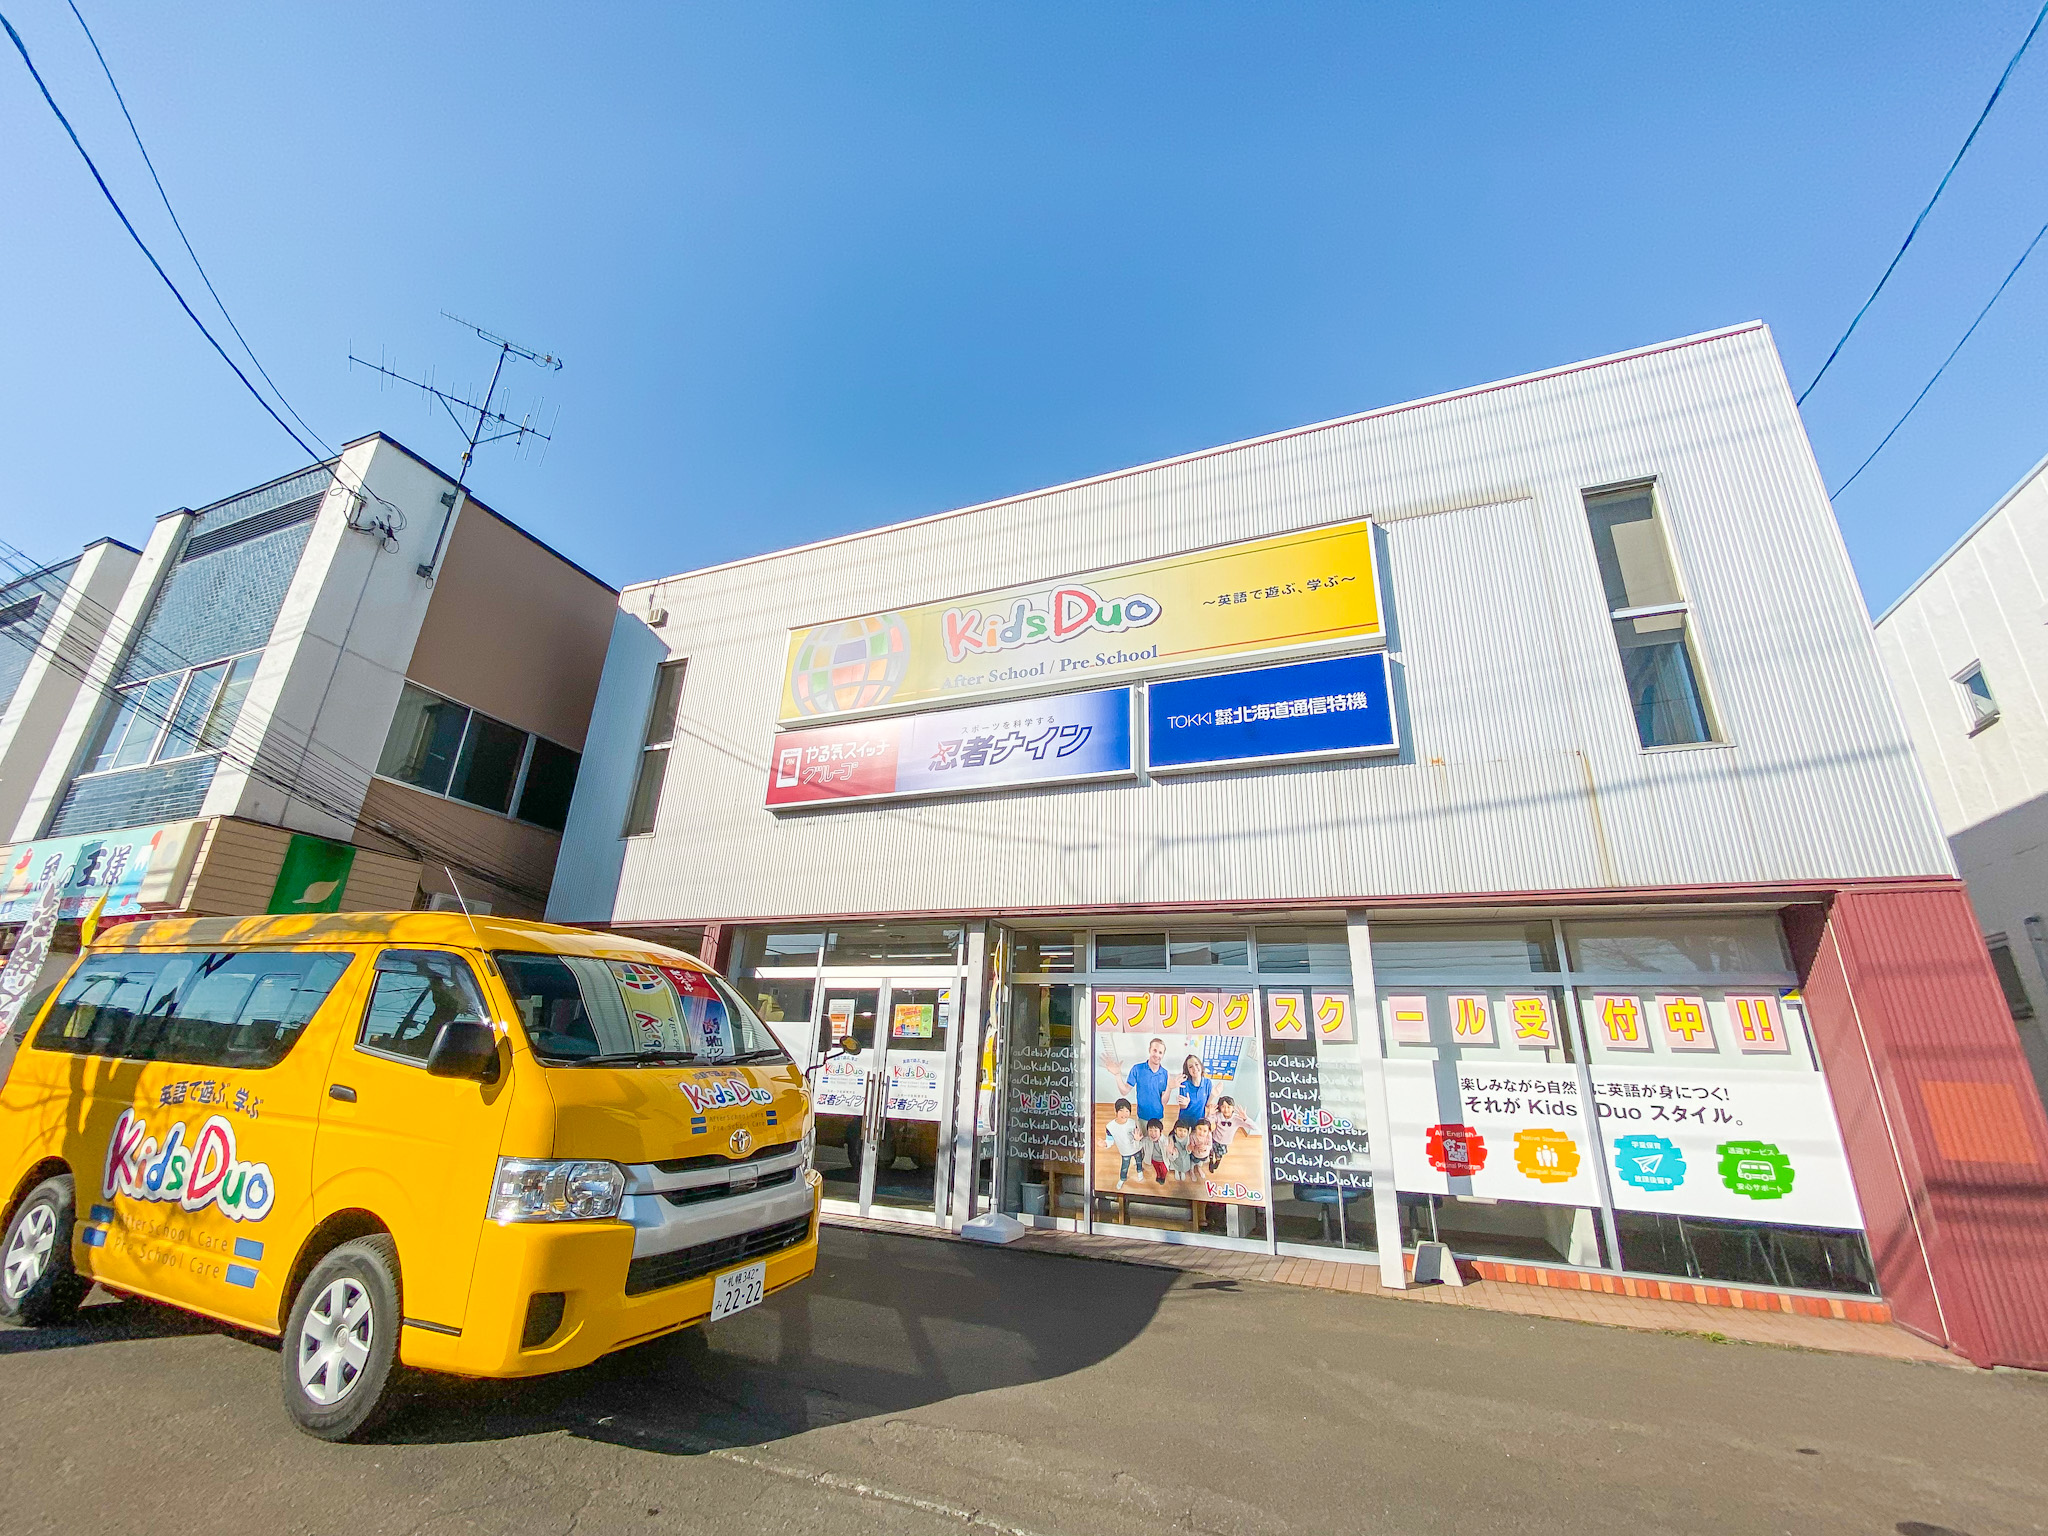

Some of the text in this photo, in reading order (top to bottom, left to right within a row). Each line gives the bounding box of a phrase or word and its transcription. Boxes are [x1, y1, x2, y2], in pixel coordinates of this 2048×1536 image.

[941, 674, 985, 690] After
[988, 662, 1045, 683] School
[961, 715, 1055, 734] スポーツを科学する
[1167, 712, 1212, 729] TOKKI
[805, 740, 891, 764] やる気スイッチ
[928, 724, 1093, 771] 忍者ナイン
[802, 761, 859, 785] グループ
[1464, 1096, 1744, 1127] それが Kids Duo スタイル。
[198, 1231, 228, 1252] Care
[140, 1244, 183, 1269] School
[190, 1257, 220, 1279] Care
